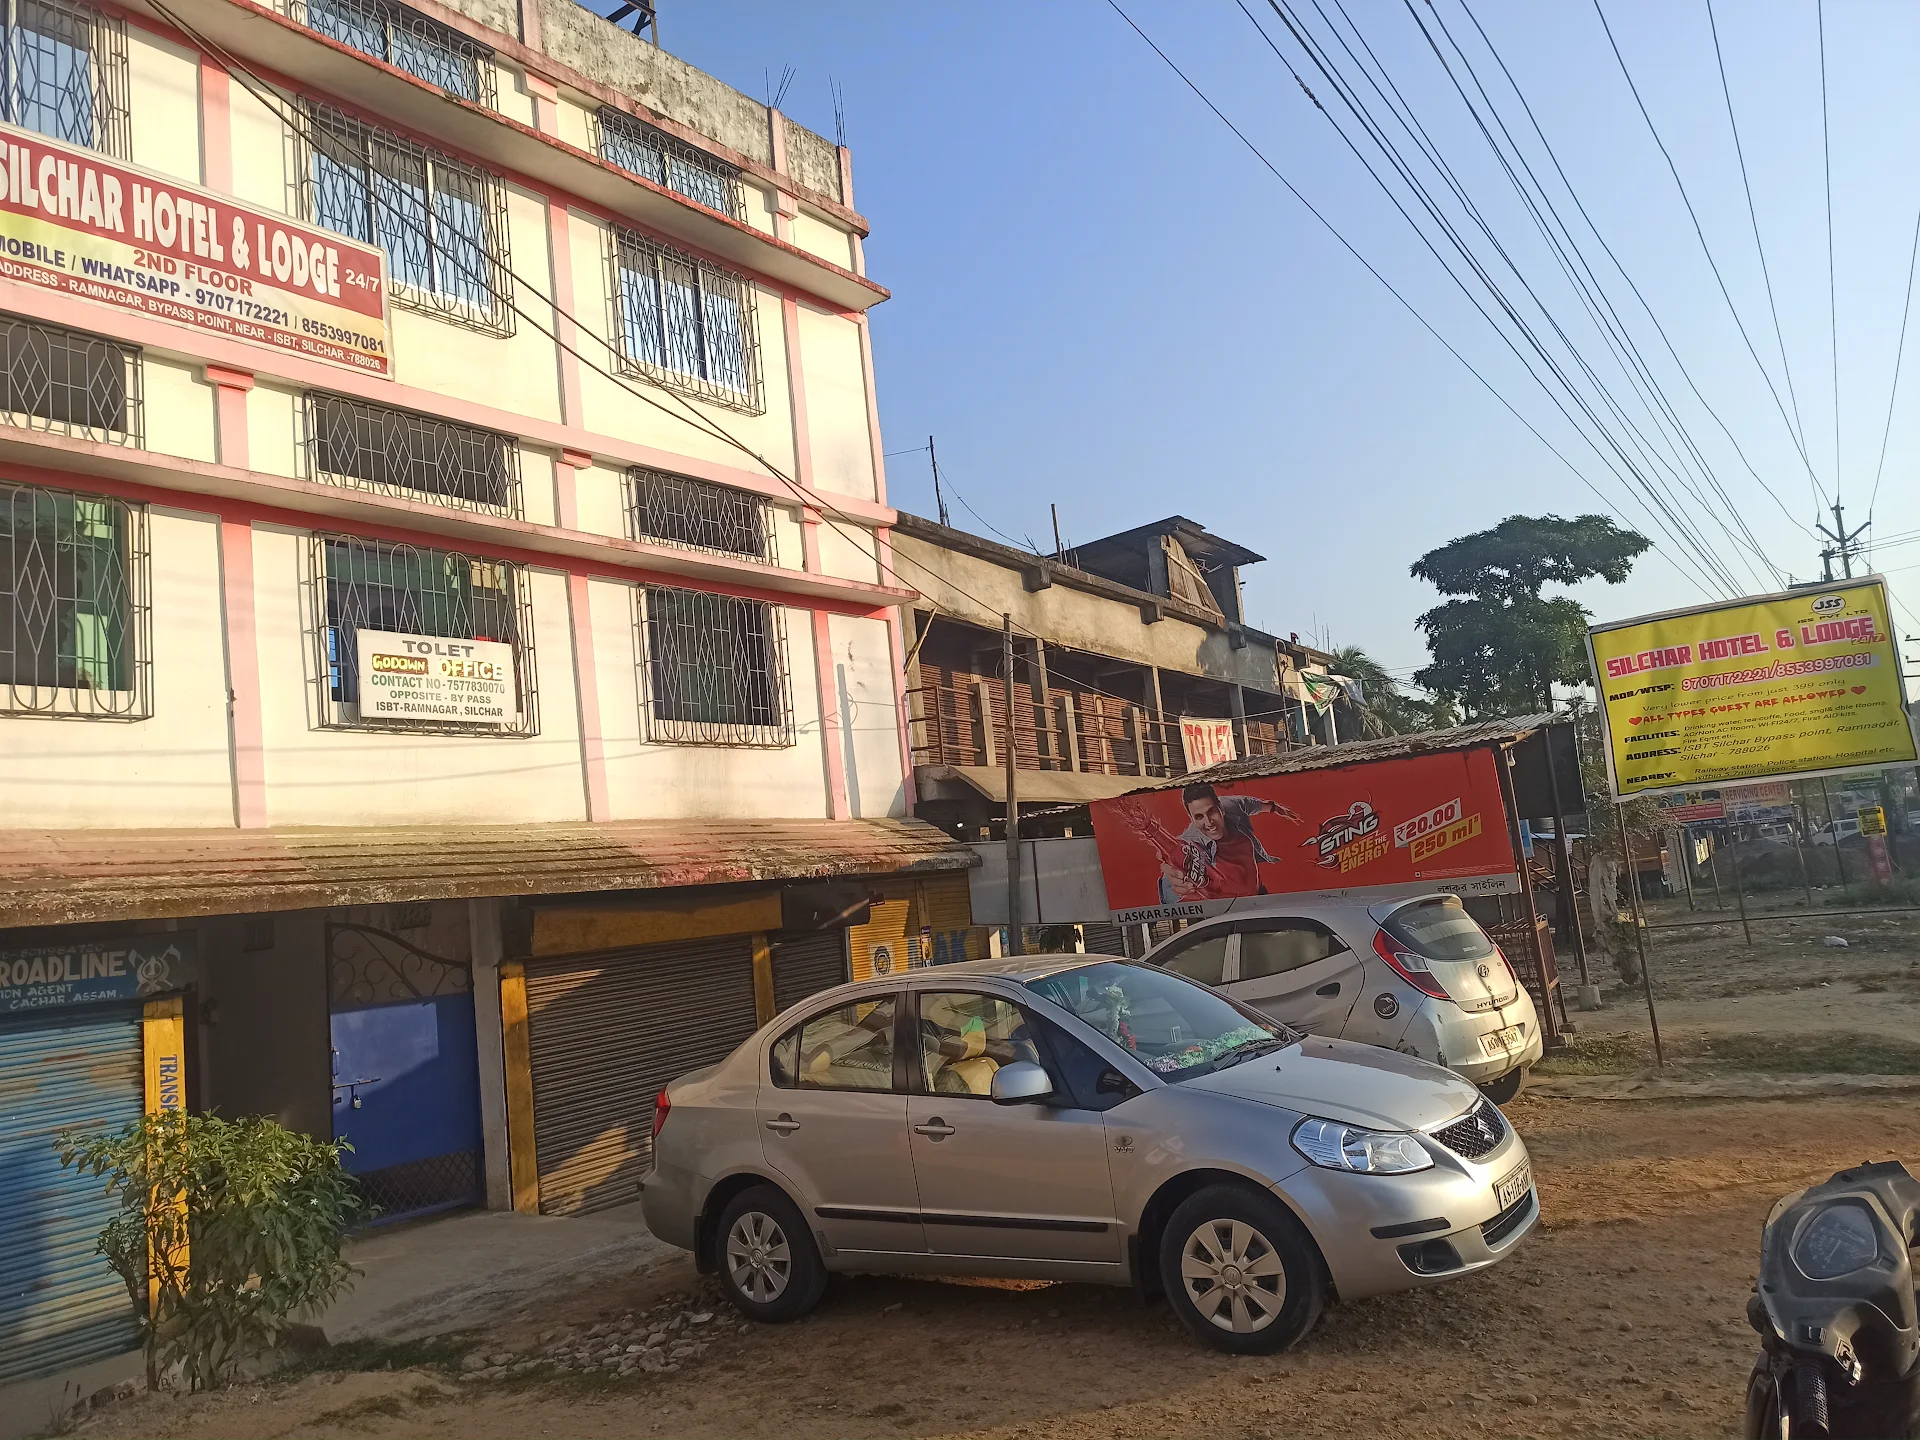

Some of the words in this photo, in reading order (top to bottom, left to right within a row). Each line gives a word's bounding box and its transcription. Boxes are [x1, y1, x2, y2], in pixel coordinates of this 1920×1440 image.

[0, 139, 125, 233] SILCHAR
[132, 183, 224, 262] HOTEL
[231, 215, 250, 271] &
[257, 223, 341, 298] LODGE
[345, 269, 380, 293] 24/7
[133, 249, 177, 276] 2ND
[184, 262, 253, 297] FLOOR
[81, 257, 180, 297] WHATSAPP
[195, 288, 289, 327] 9707172221
[302, 318, 384, 354] 8553997081
[69, 280, 146, 310] RAMNAGAR,
[148, 298, 194, 322] BYPASS
[198, 310, 232, 333] POINT,
[235, 322, 265, 340] NEAR
[274, 331, 298, 350] ISBT,
[301, 338, 345, 360] SILCHAR
[1606, 645, 1693, 678] SILCHAR
[1698, 634, 1769, 662] HOTEL
[1775, 629, 1795, 649] &
[1802, 616, 1874, 646] LODGE
[372, 674, 422, 688] CONTACT
[439, 658, 503, 681] OFFICE
[390, 690, 442, 701] OPPOSITE
[450, 694, 464, 702] BY
[468, 695, 492, 704] PASS
[1642, 702, 1668, 712] Very
[1670, 699, 1702, 708] lower
[1704, 694, 1734, 705] price
[1766, 686, 1789, 696] just
[1792, 682, 1814, 691] 399
[1818, 678, 1846, 688] only
[1643, 713, 1665, 726] ALL
[1666, 706, 1706, 722] TYPES
[1710, 701, 1750, 716] GUEST
[1754, 698, 1779, 711] ARE
[1782, 688, 1846, 708] ALLOWED
[464, 706, 503, 716] SILCHAR
[1683, 743, 1710, 752] ISBT
[1712, 738, 1751, 748] Silchar
[1754, 732, 1795, 744] Bypass
[1798, 728, 1832, 739] point,
[1836, 720, 1900, 733] Ramnagar,
[1684, 723, 1717, 732] Drinking
[1680, 752, 1718, 762] Silchar
[1728, 744, 1770, 756] 788026
[1694, 766, 1729, 774] Railway
[1766, 758, 1796, 766] Police
[1836, 748, 1876, 759] Hospital
[1758, 765, 1798, 774] distance
[1724, 785, 1758, 800] SERVICING
[1760, 783, 1785, 797] CENTER
[1320, 815, 1378, 856] STING
[1336, 838, 1374, 863] TASTE
[1374, 834, 1387, 844] THE
[1414, 831, 1447, 858] 250
[1340, 842, 1390, 874] ENERGY
[1117, 910, 1161, 924] LASKAR
[1163, 904, 1204, 916] SAILEN
[26, 982, 74, 996] AGENT
[1476, 996, 1510, 1009] HYUNDAI
